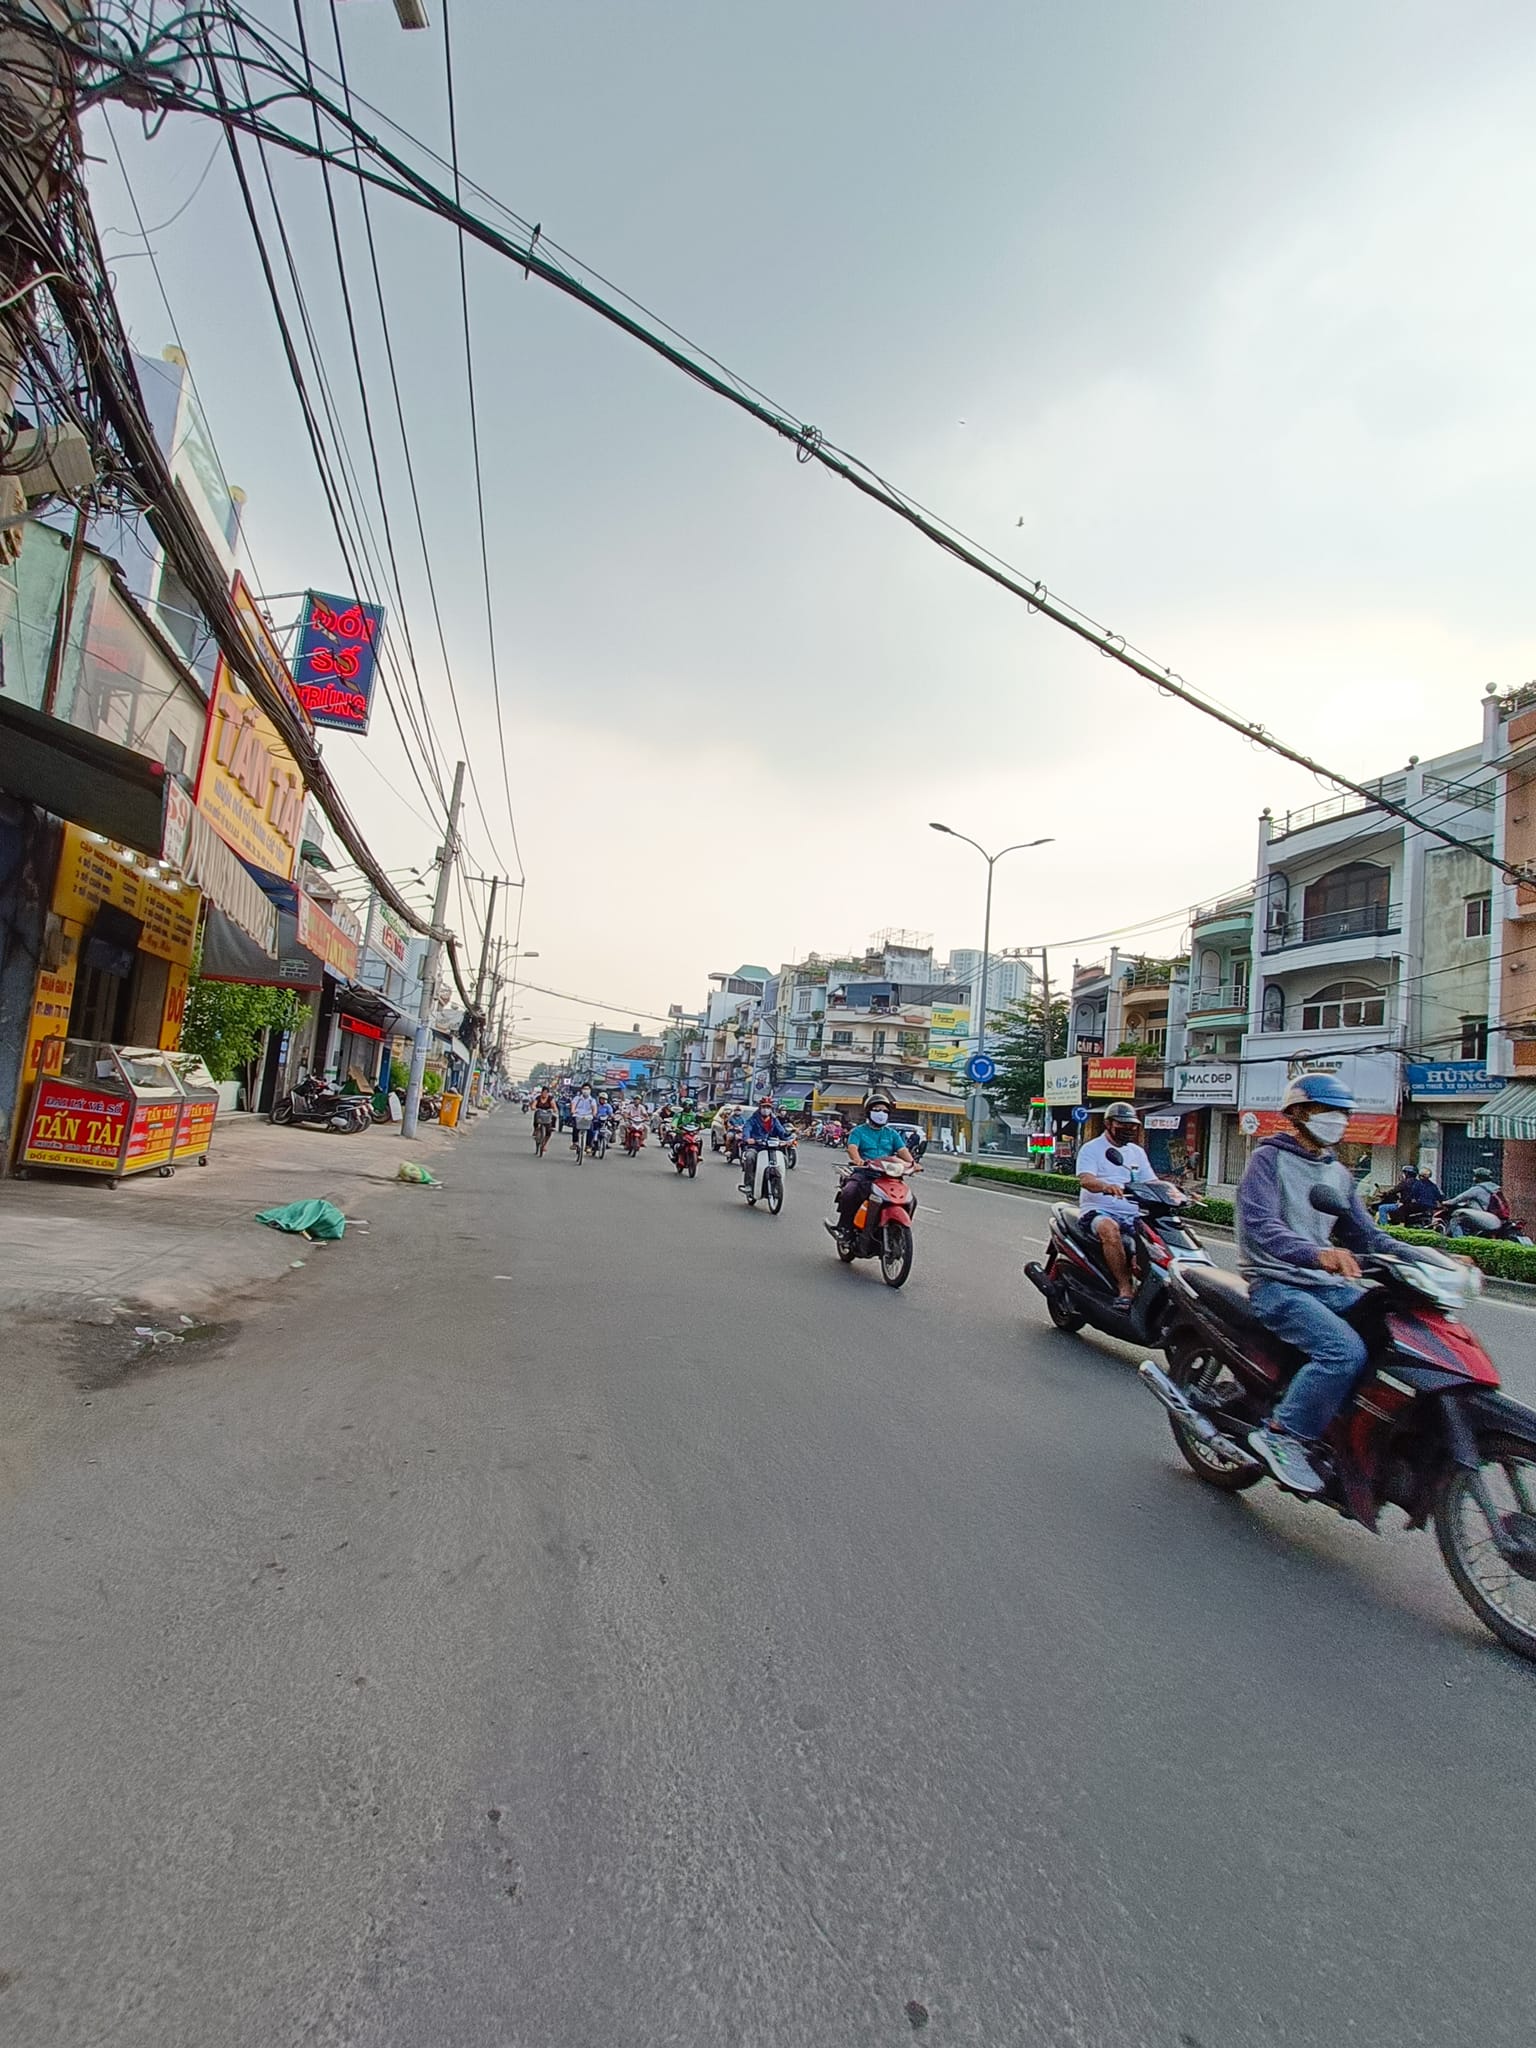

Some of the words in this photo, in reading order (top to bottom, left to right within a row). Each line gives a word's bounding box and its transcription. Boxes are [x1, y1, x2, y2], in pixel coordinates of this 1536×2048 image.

[311, 645, 362, 677] SỐ
[106, 1102, 125, 1115] SỐ
[87, 1115, 125, 1147] TÀI
